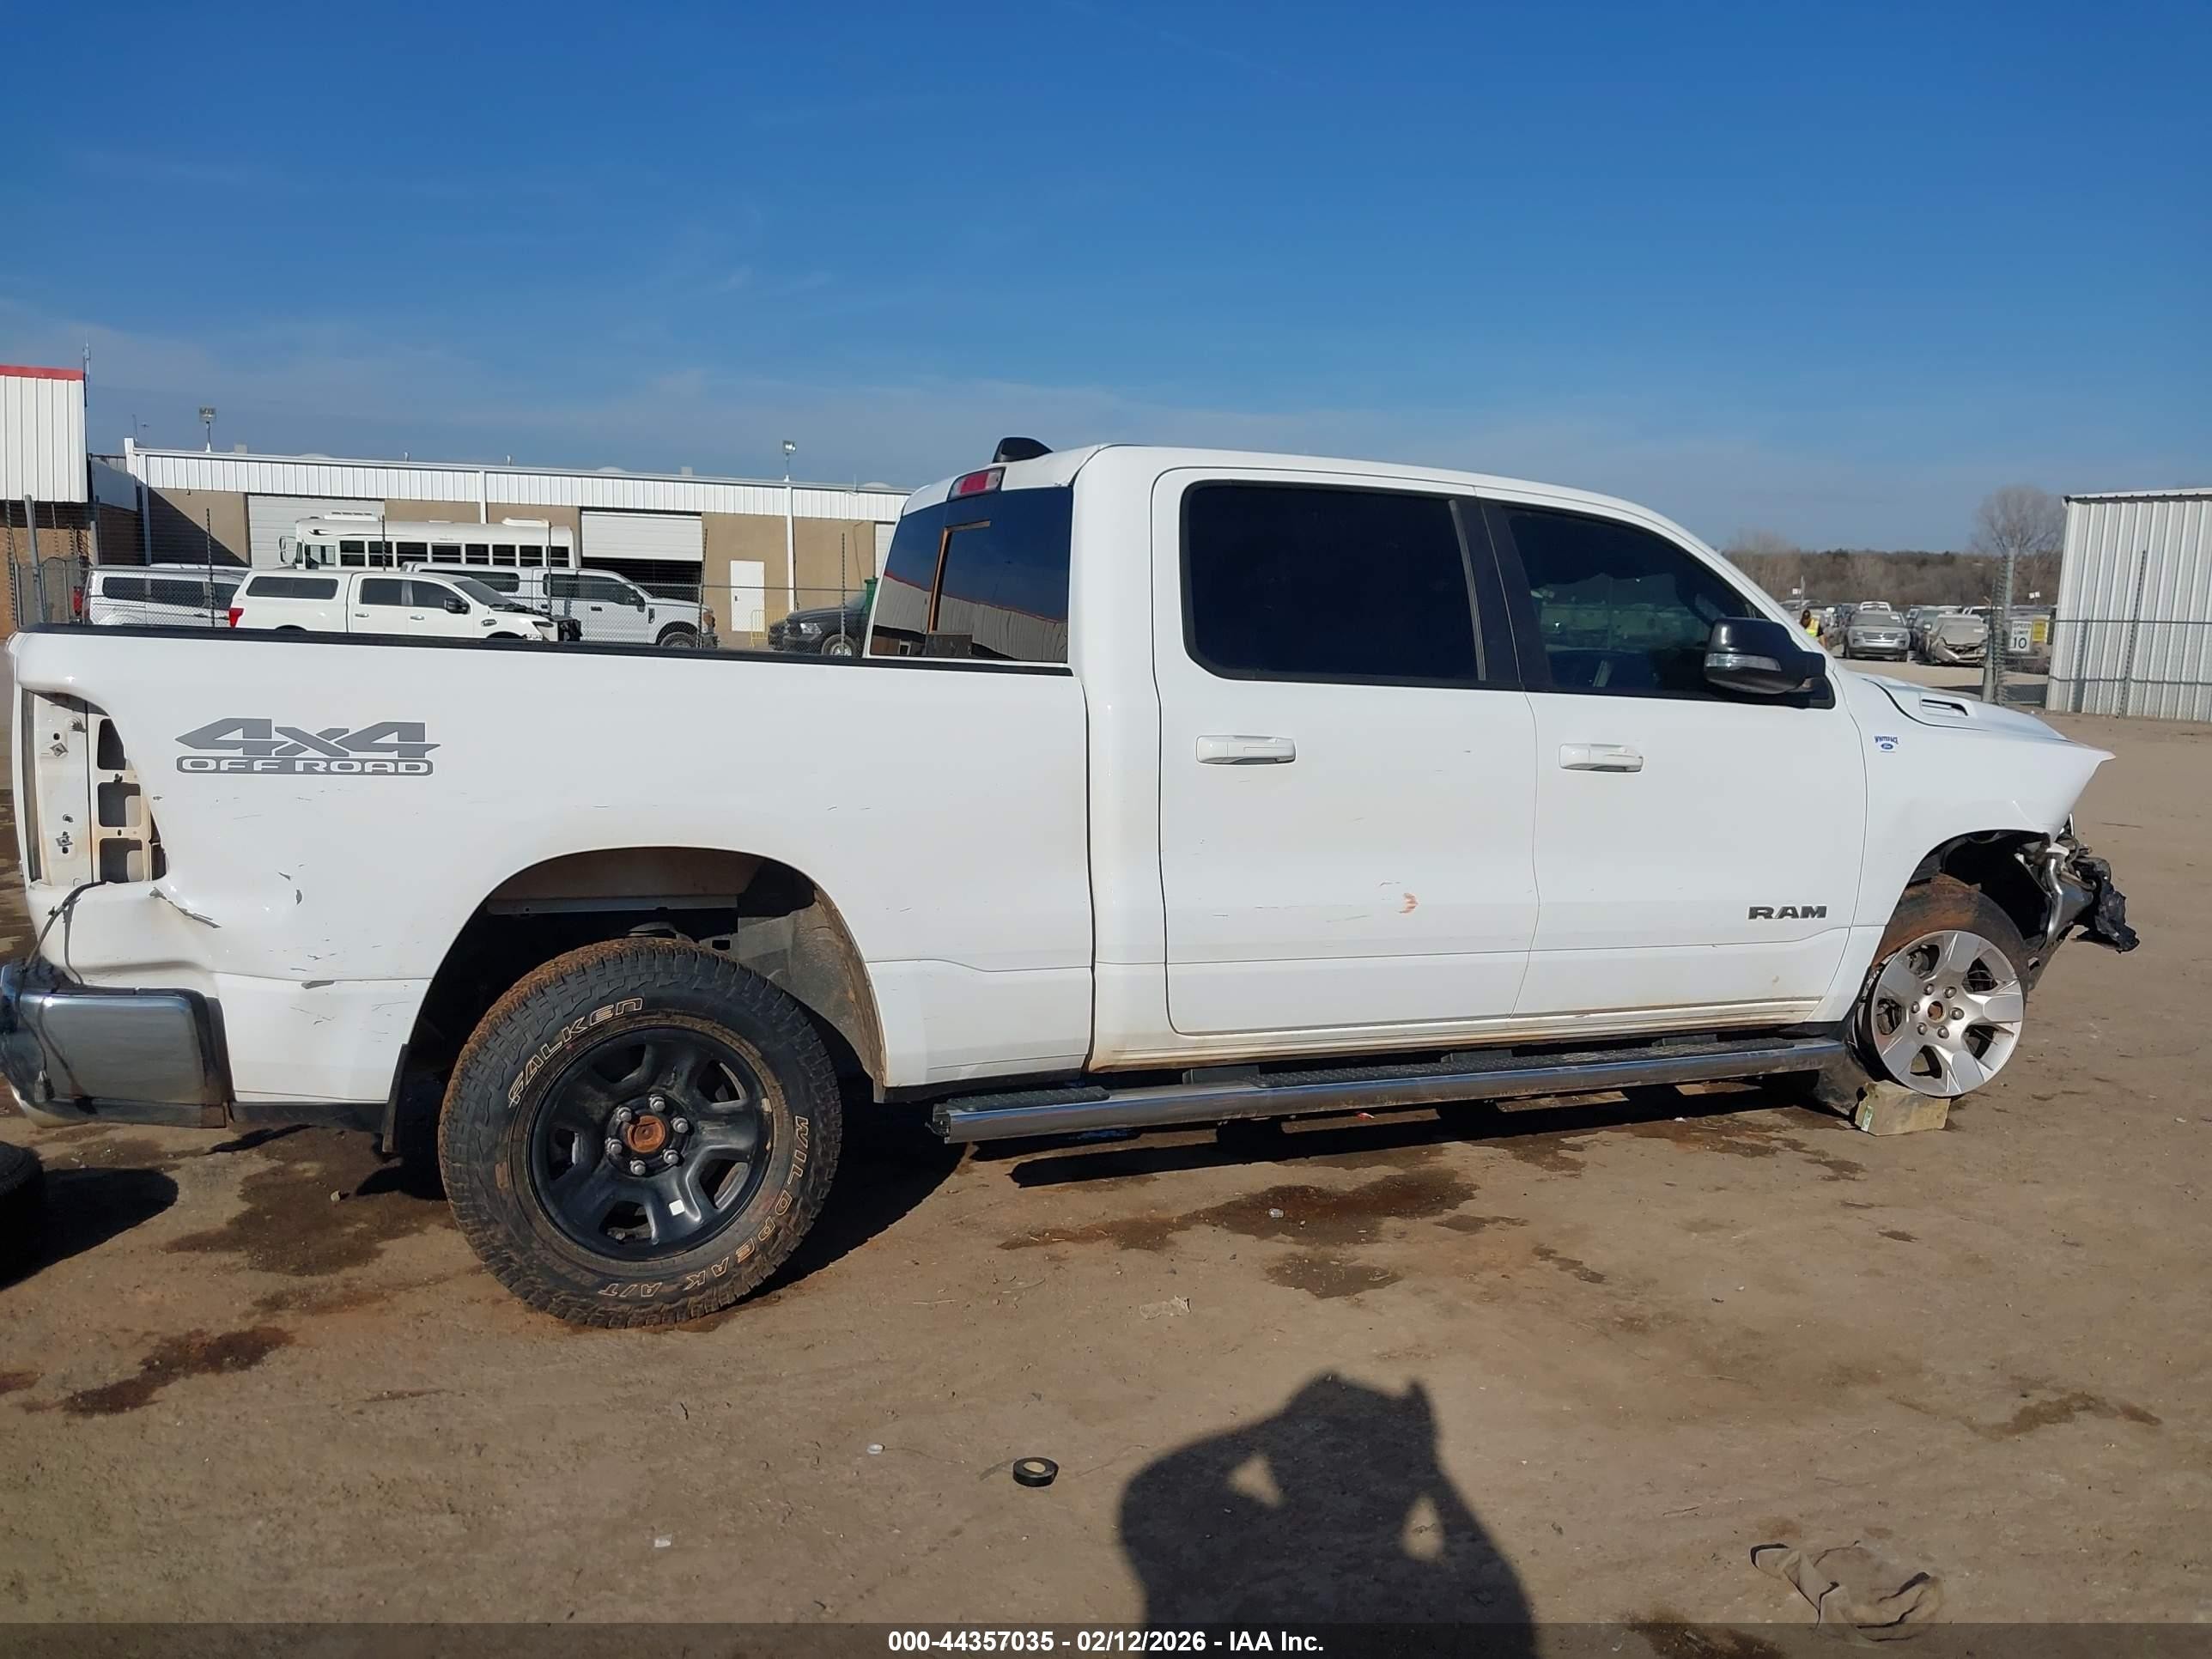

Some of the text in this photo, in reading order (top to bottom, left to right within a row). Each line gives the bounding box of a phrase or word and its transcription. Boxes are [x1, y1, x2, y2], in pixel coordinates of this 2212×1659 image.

[2013, 636, 2027, 649] 10
[182, 757, 429, 773] OFF ROAD
[1748, 906, 1827, 920] RAM
[508, 997, 643, 1109] FALKEN
[598, 1115, 809, 1297] WILDPEAK A/T
